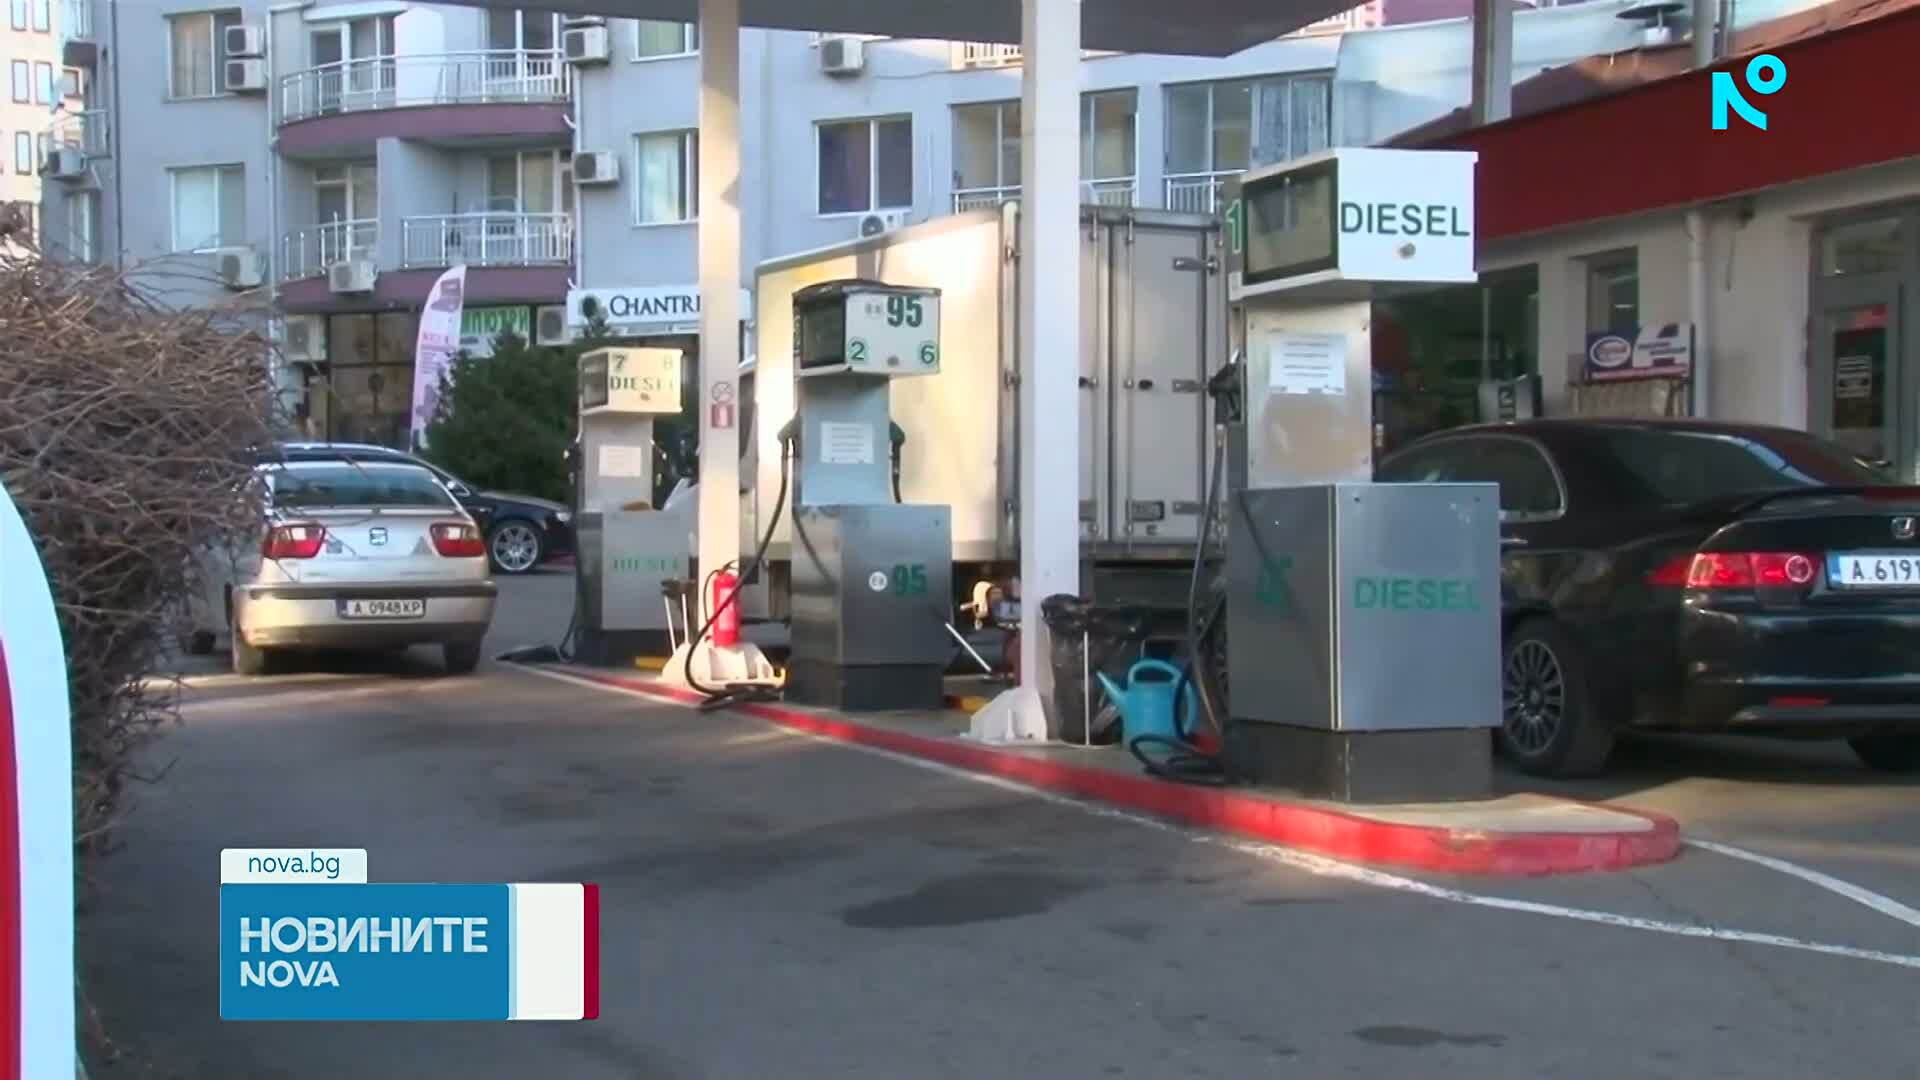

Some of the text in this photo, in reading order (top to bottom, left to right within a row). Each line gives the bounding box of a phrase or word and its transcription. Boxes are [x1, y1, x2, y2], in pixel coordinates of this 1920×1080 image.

[1340, 202, 1471, 237] DIESEL
[887, 295, 923, 327] 95
[613, 354, 626, 371] 7
[850, 340, 865, 362] 2
[920, 344, 936, 364] 6
[892, 564, 929, 596] 95
[1852, 559, 1865, 580] A
[1354, 578, 1482, 611] DIESEL
